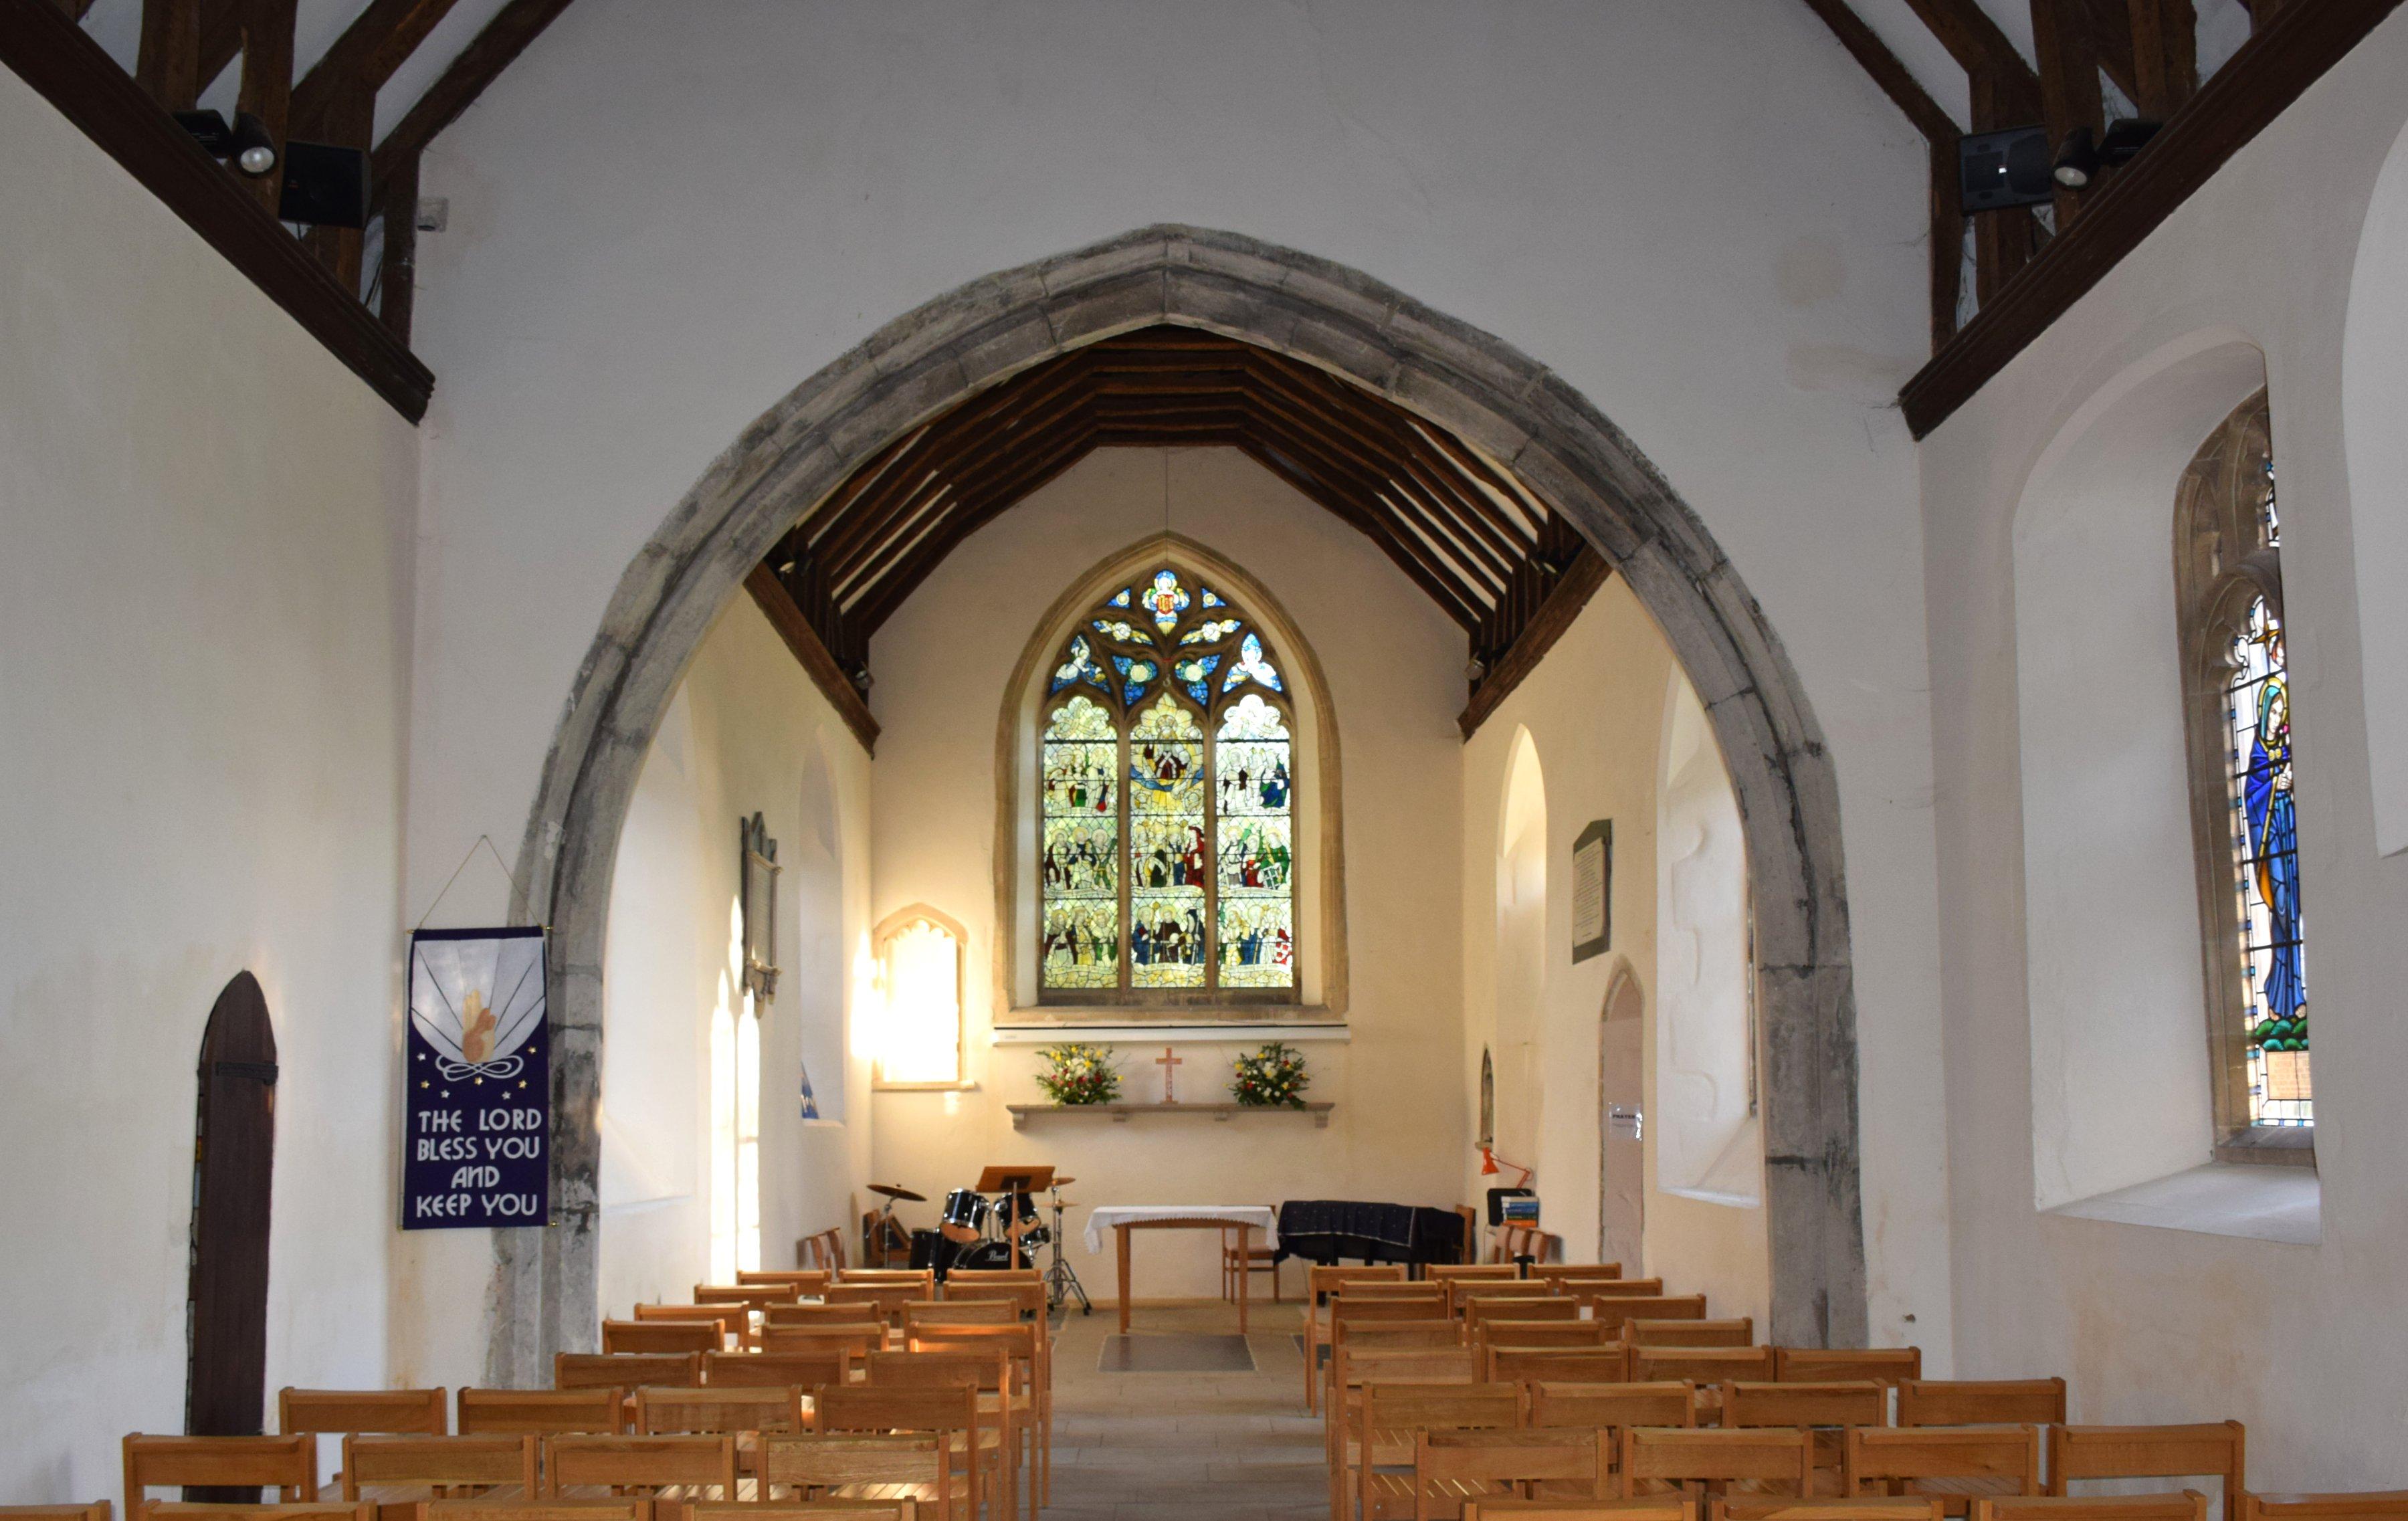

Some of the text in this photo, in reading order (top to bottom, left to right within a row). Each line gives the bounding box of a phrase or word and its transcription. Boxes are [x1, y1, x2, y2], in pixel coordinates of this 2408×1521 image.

[418, 1108, 542, 1132] THE LORD
[417, 1136, 539, 1161] BLESS YOU
[451, 1166, 500, 1189] AND
[417, 1193, 537, 1217] KEEP YOU
